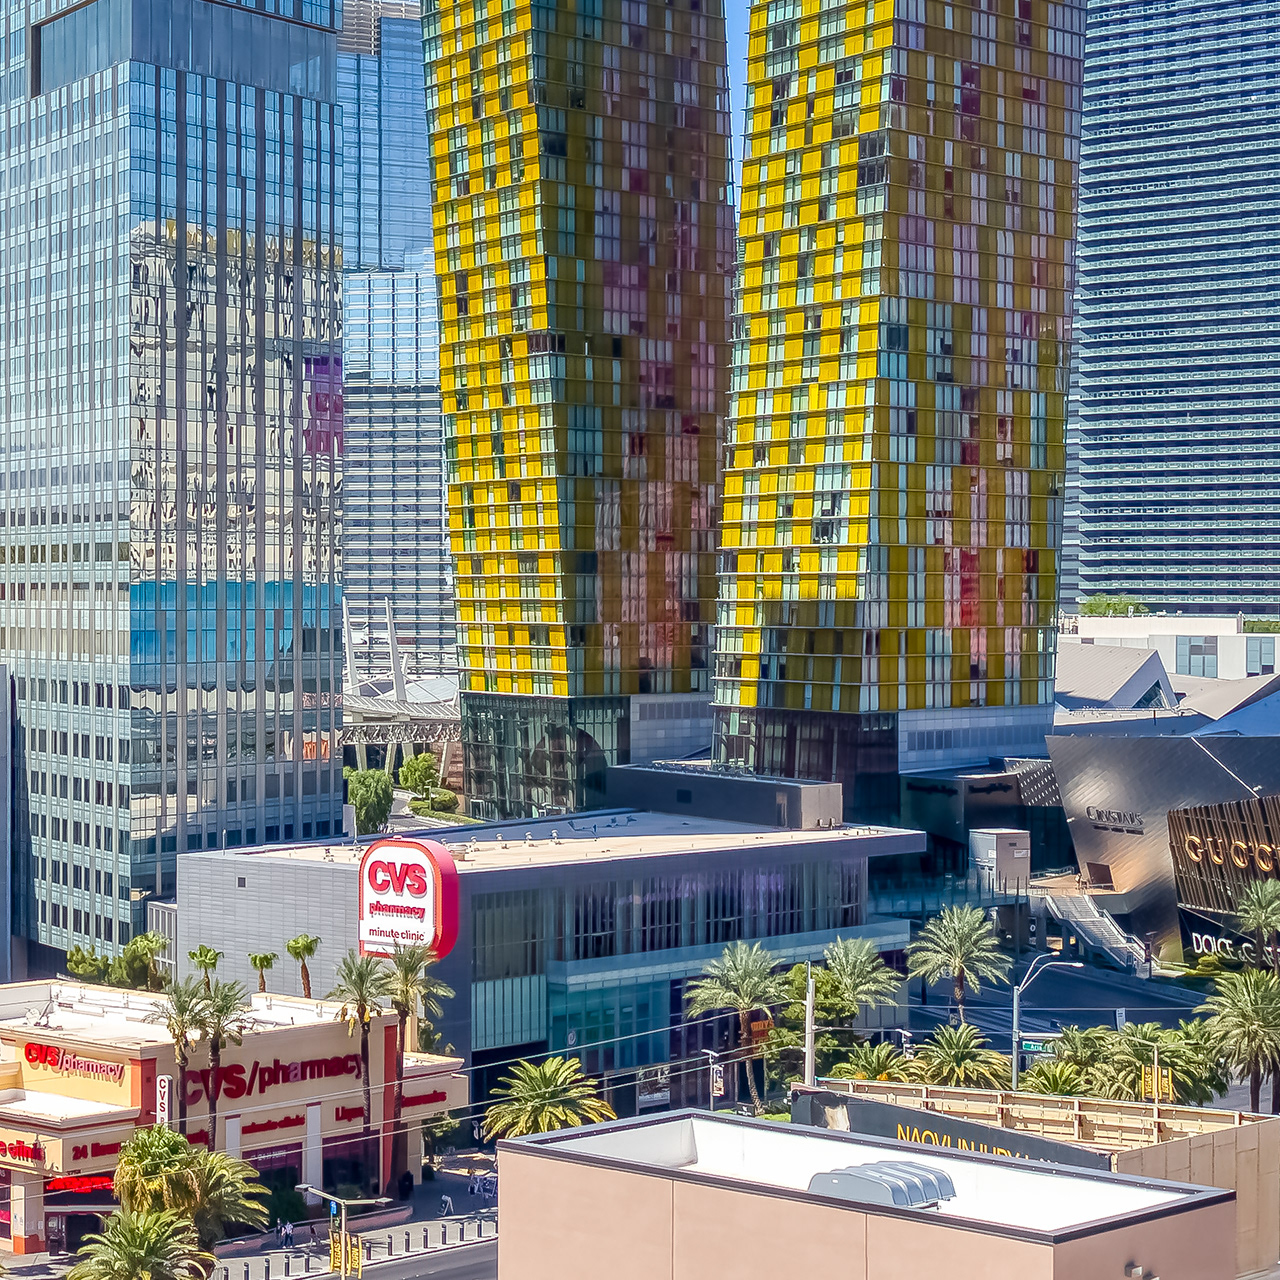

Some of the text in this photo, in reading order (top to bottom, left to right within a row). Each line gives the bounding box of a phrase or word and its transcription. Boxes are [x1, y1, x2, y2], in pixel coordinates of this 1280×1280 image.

[368, 860, 428, 896] CVS
[369, 900, 426, 921] pharmacy
[368, 927, 425, 941] minute clinic
[1192, 932, 1238, 960] DOLCE
[25, 1042, 124, 1080] CVS/pharmacy
[159, 1078, 167, 1113] CVS
